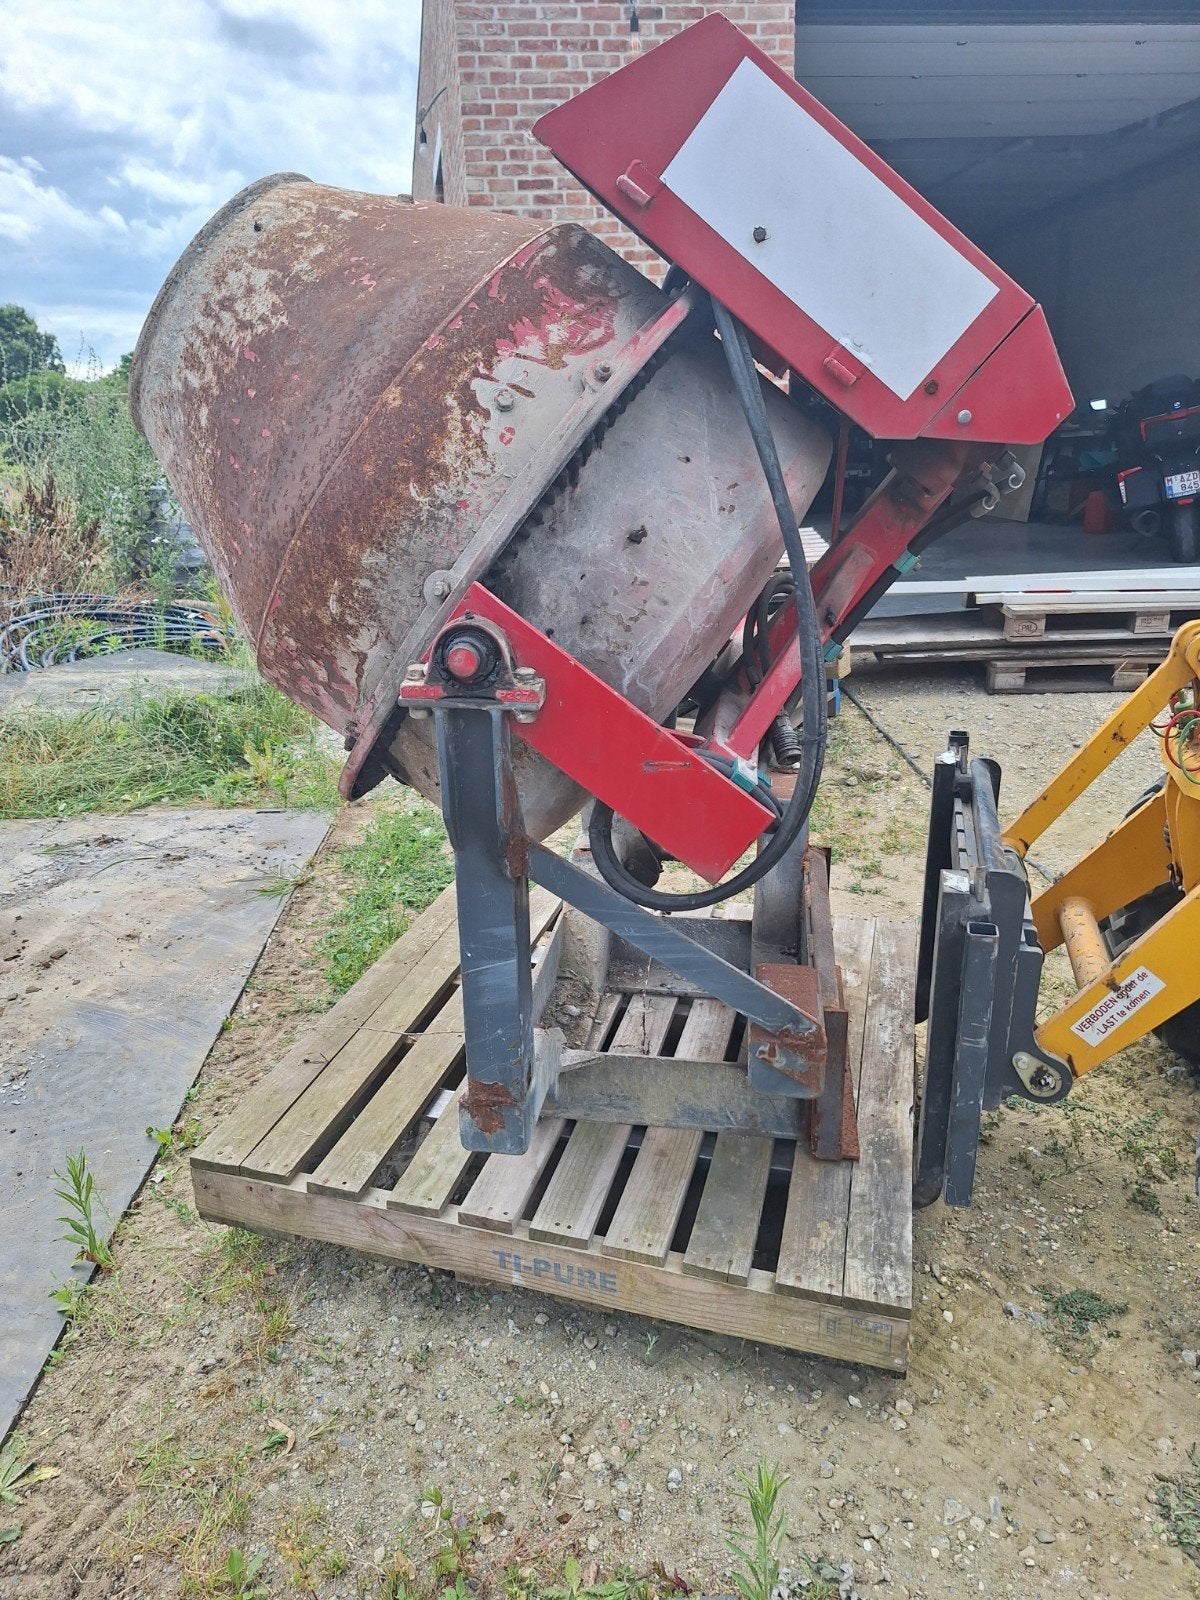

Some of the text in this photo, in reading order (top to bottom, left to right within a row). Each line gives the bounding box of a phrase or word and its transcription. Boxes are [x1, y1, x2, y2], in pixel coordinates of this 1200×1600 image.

[1180, 472, 1198, 482] AZD
[1181, 481, 1199, 491] 845
[1075, 971, 1148, 1033] VERBODEN onder de
[1097, 989, 1151, 1035] LAST te komen
[492, 1250, 617, 1293] TI-PURE
